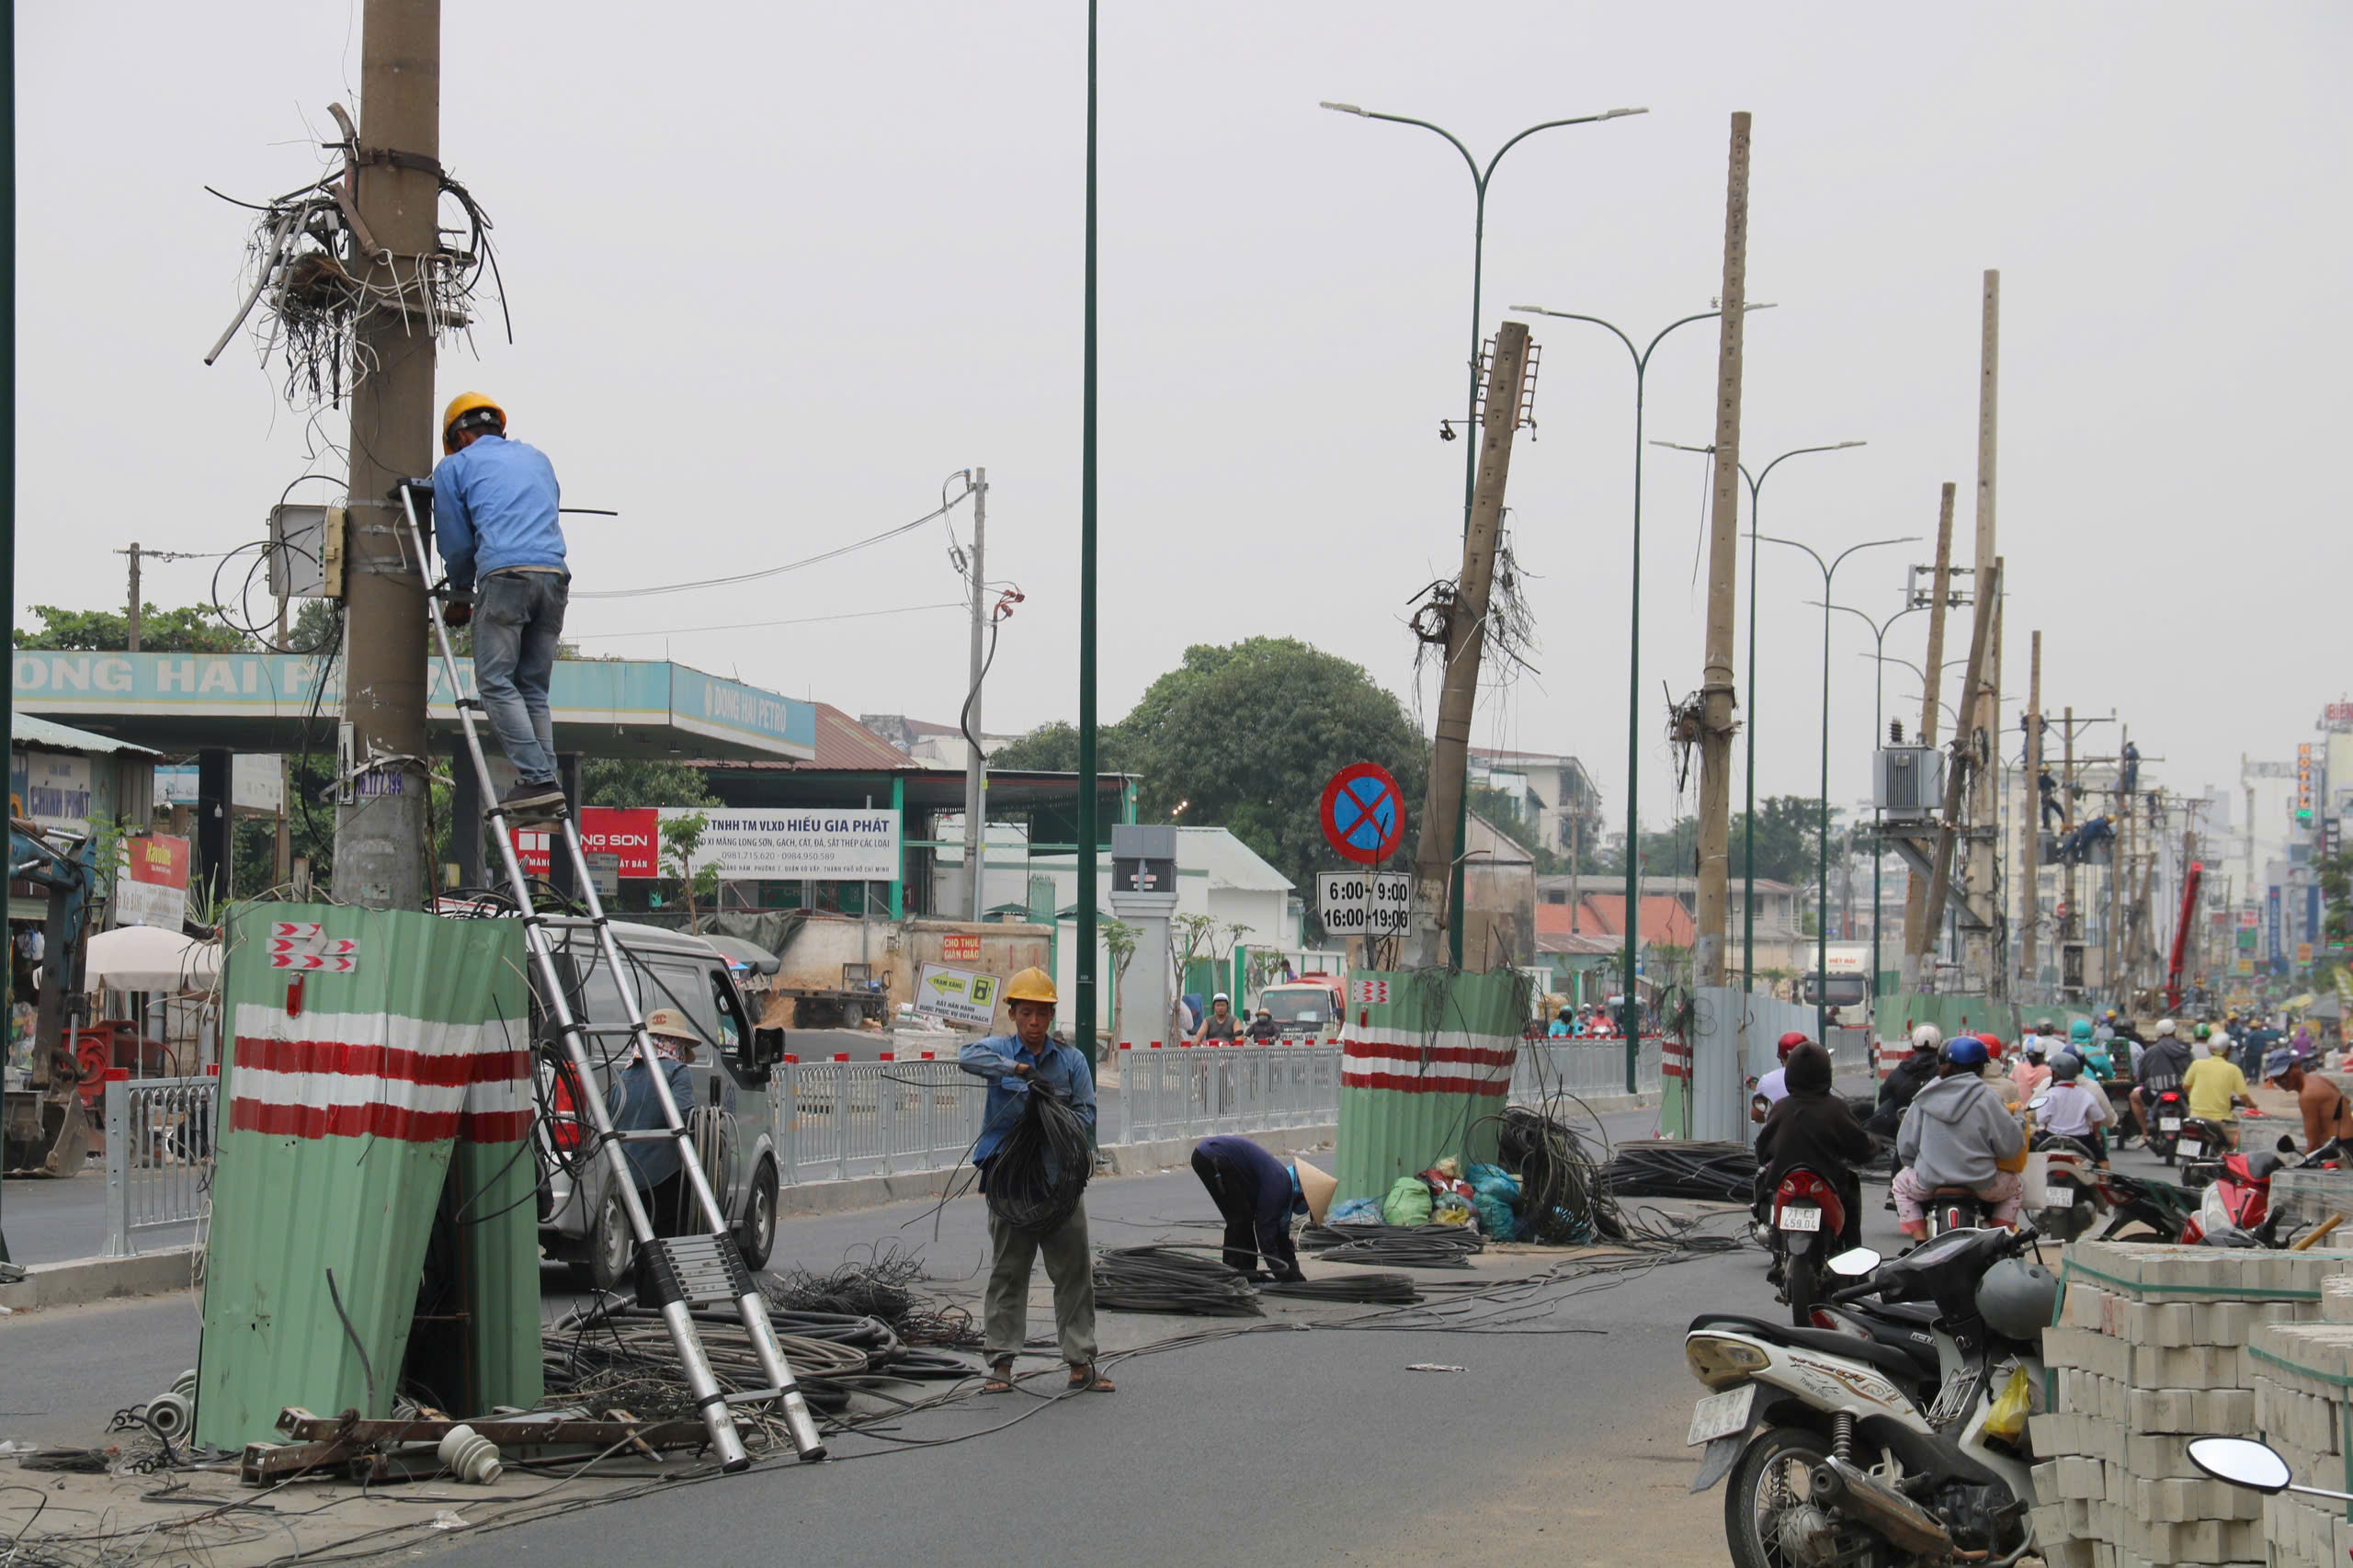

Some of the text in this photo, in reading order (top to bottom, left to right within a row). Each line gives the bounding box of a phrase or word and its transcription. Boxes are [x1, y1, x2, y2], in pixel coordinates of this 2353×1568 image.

[13, 656, 133, 692] ONG
[156, 660, 257, 694] HAI
[742, 691, 756, 725] HAI
[758, 698, 787, 734] PETRO
[710, 820, 740, 831] TNHH
[742, 820, 757, 831] TM
[759, 821, 785, 832] VLXD
[787, 815, 821, 832] HIẾU
[824, 820, 849, 832] GIA
[852, 817, 890, 833] PHÁT
[609, 835, 648, 846] SON
[707, 837, 714, 846] XI
[716, 835, 736, 846] MĂNG
[738, 837, 757, 846] LONG
[841, 837, 858, 848] THÉP
[860, 837, 872, 847] CÁC
[874, 838, 890, 850] LOẠI
[722, 851, 835, 861] 0981.715.620 0984.950.589
[875, 865, 890, 873] MINH
[1378, 882, 1408, 902] 9:00
[944, 937, 959, 949] CHO
[1788, 1209, 1815, 1220] 71-C3
[1783, 1219, 1816, 1230] 459.04
